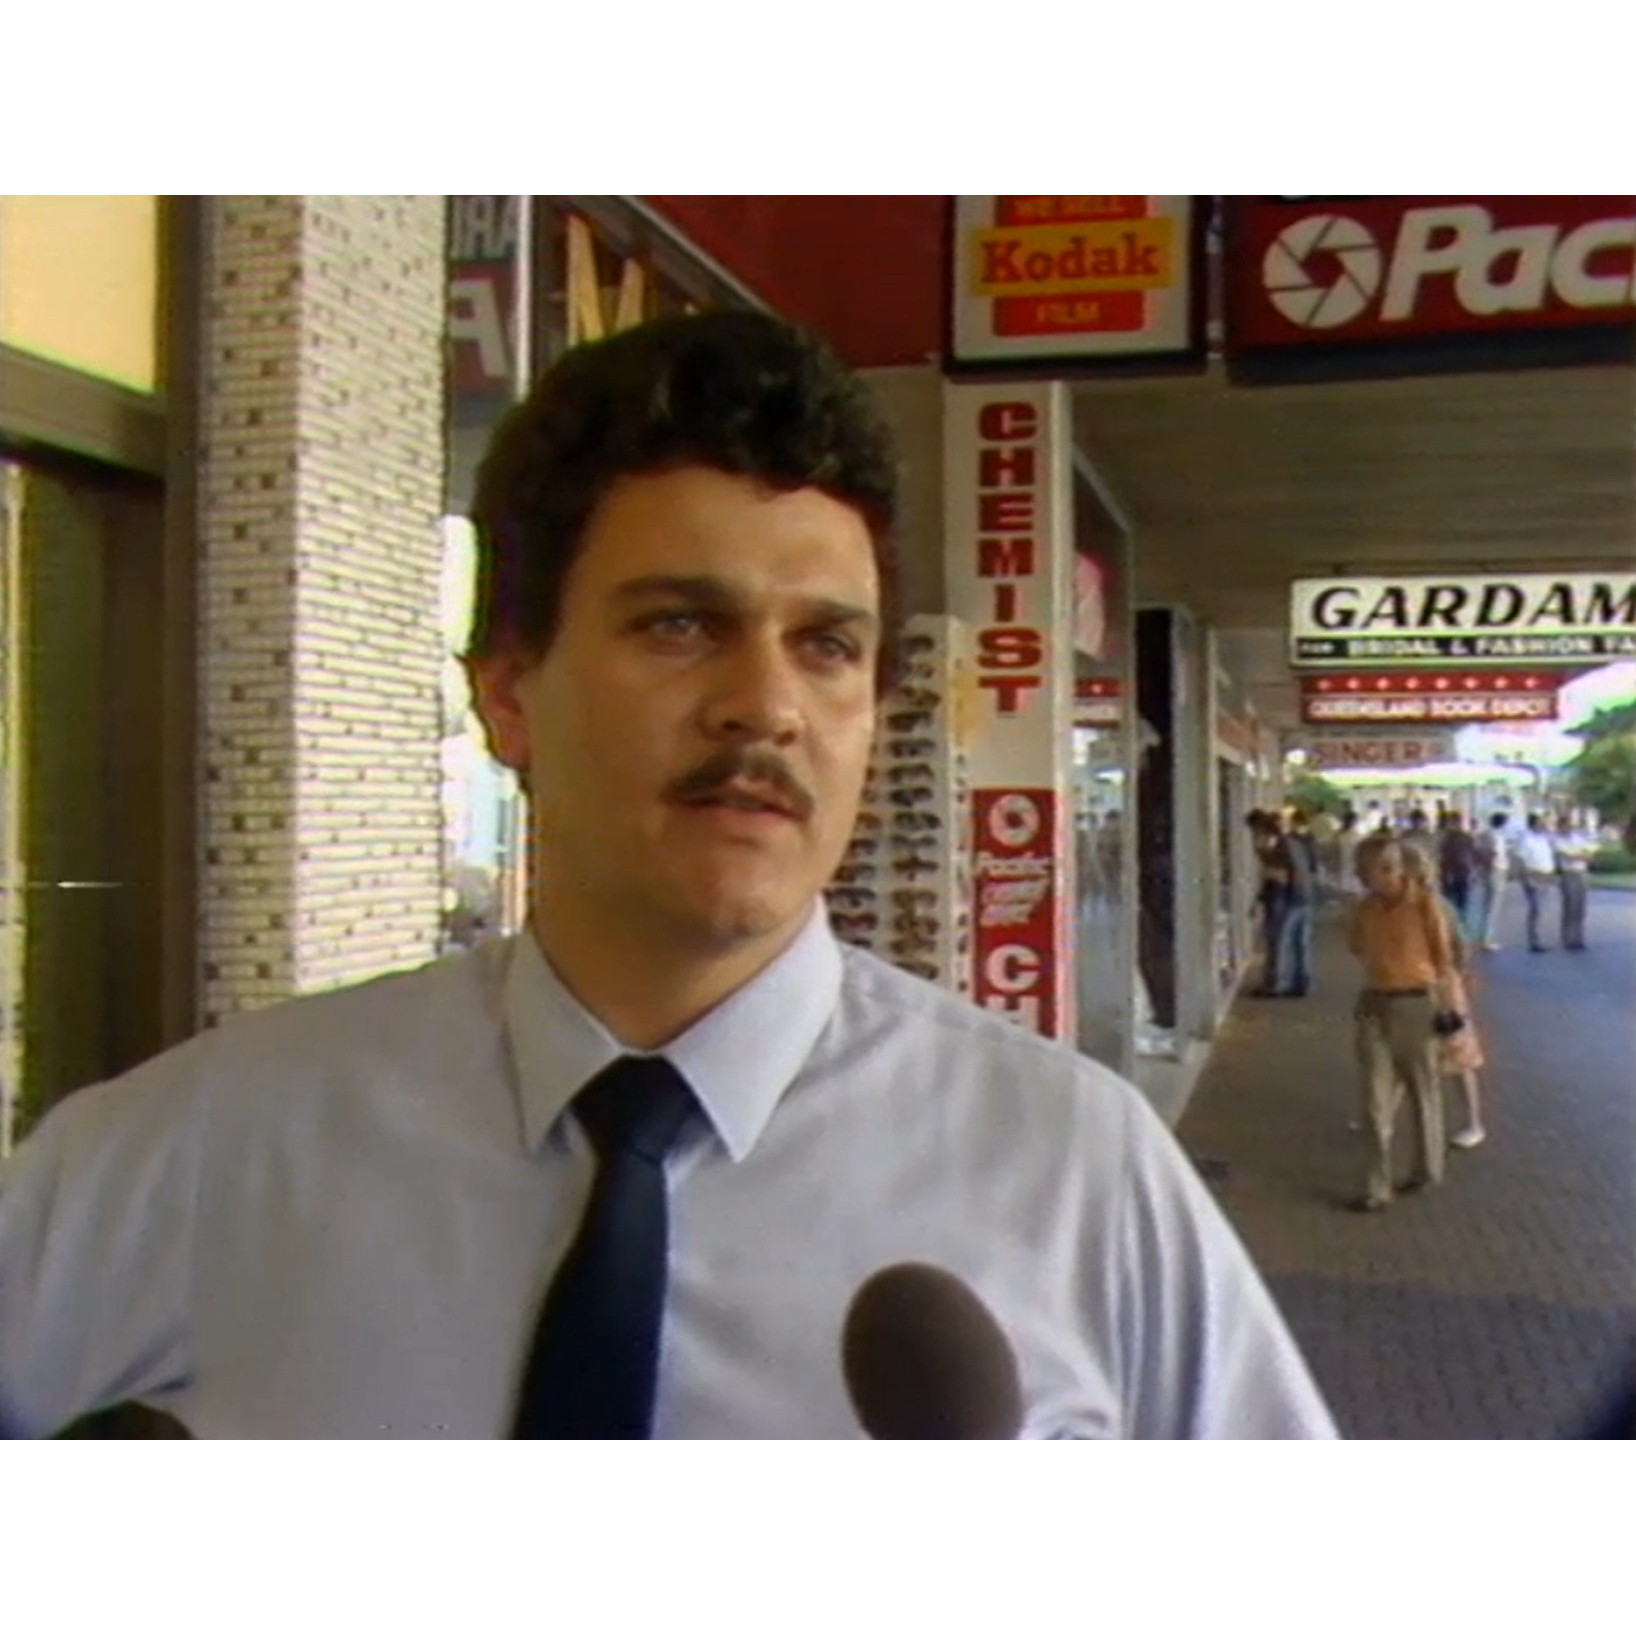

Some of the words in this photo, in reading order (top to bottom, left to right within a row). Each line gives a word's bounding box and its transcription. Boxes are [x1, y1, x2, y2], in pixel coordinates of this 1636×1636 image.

[980, 232, 1160, 285] Kodak
[1379, 205, 1636, 322] Pac
[978, 402, 1042, 712] CHEMIST
[1311, 583, 1636, 629] GARDAM
[1348, 638, 1439, 656] BRIDAL
[1475, 636, 1594, 655] FASHION
[1308, 740, 1422, 763] SINGER
